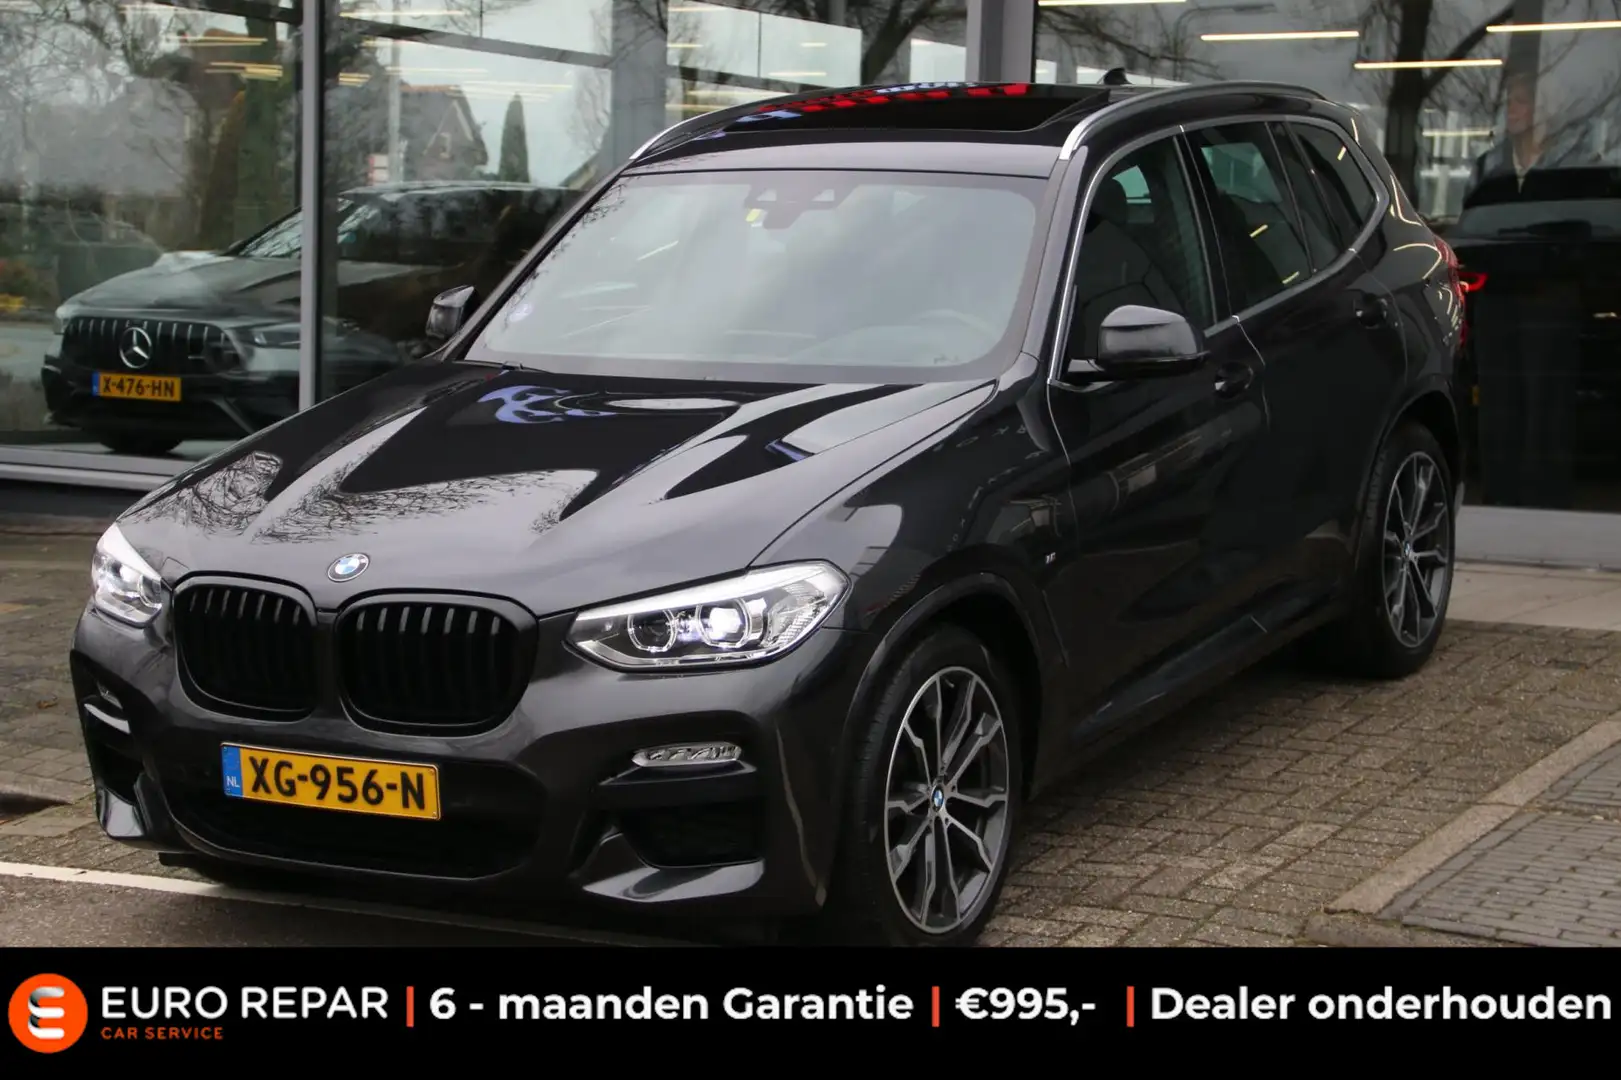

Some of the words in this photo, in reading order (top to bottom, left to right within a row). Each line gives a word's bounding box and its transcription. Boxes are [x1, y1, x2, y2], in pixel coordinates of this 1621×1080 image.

[102, 375, 175, 397] X-476-HN
[226, 775, 240, 789] NL
[249, 755, 425, 811] XG-956-N
